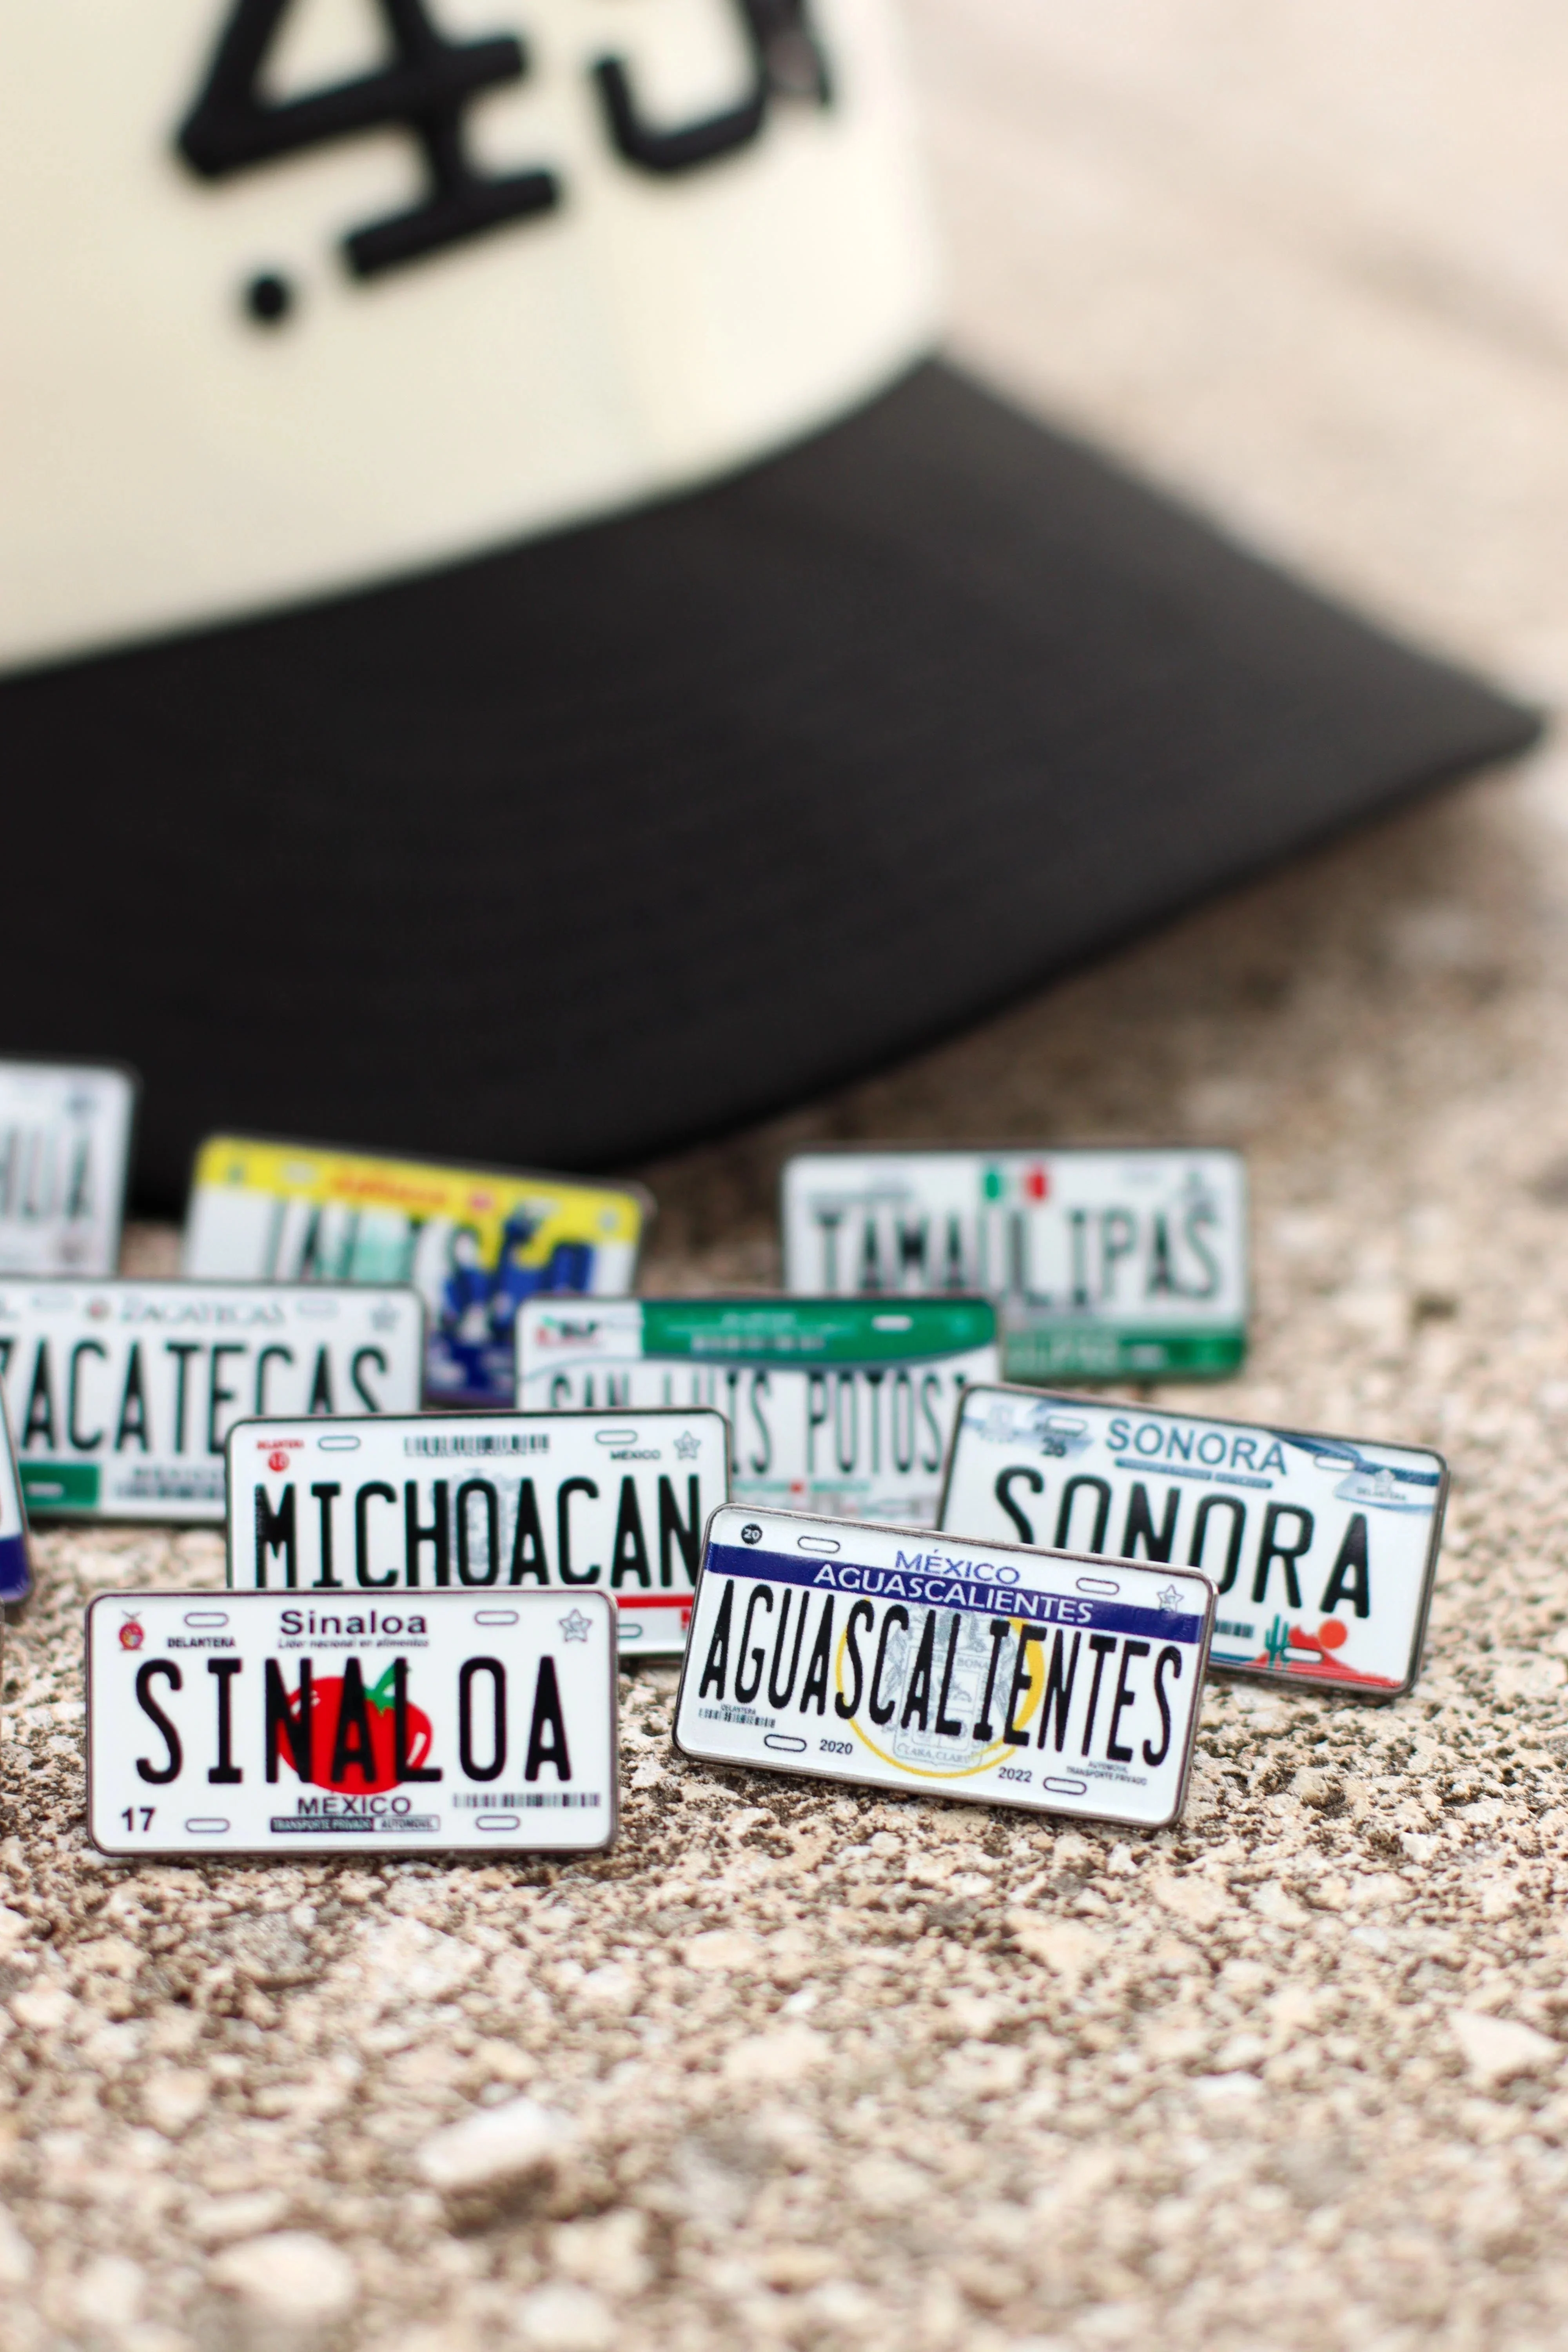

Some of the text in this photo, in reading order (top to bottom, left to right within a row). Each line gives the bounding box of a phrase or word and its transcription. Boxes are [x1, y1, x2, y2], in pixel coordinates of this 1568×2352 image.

[815, 1205, 1221, 1308] TAMAULIPAS
[806, 1368, 968, 1475] POTOS
[1105, 1417, 1287, 1476] SONORA
[255, 1474, 700, 1588] MICHOACAN
[742, 1527, 760, 1541] 20
[994, 1465, 1371, 1619] SONORA
[895, 1549, 1021, 1585] MÉXICO
[814, 1563, 1094, 1624] AGUASCALIENTES
[167, 1636, 236, 1648] DELANTERA
[280, 1609, 427, 1635] Sinaloa
[699, 1579, 1182, 1767] AGUASCALIENTES
[135, 1655, 572, 1785] SINALOA
[819, 1738, 853, 1755] 2020
[998, 1766, 1033, 1783] 2022
[1066, 1765, 1114, 1780] TRANSPORTE
[121, 1806, 156, 1832] 17
